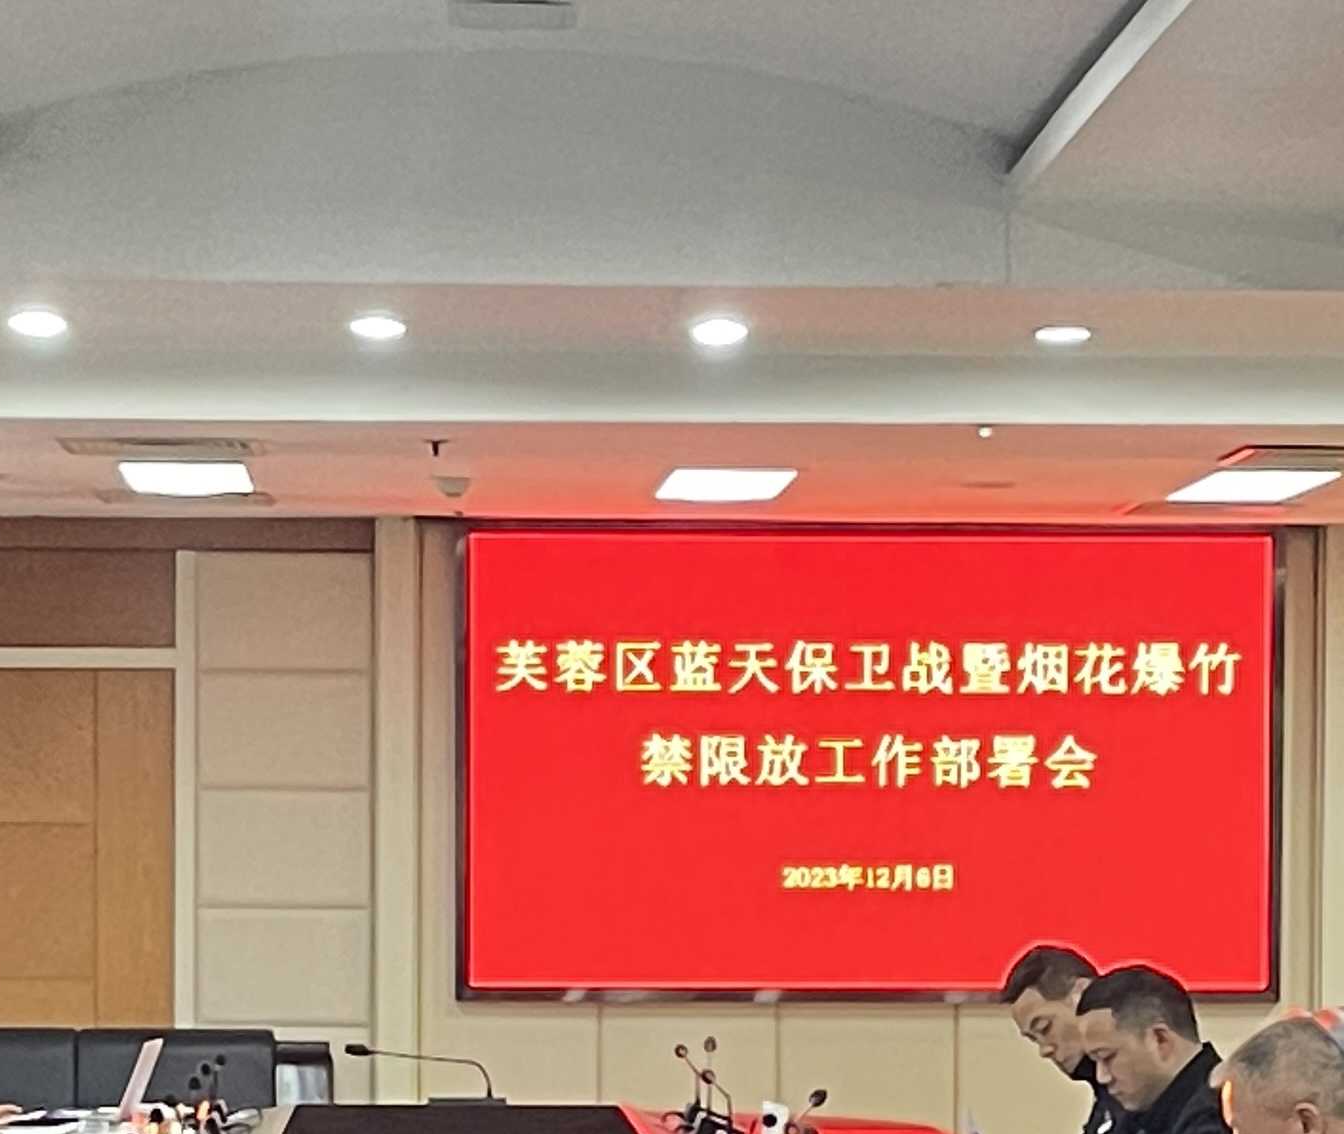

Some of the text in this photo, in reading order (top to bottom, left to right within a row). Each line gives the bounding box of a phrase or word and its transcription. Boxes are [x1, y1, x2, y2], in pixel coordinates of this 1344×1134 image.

[496, 639, 1241, 695] 芙蓉区蓝天保卫战暨烟花爆竹
[641, 733, 1096, 788] 禁限放工作部署会
